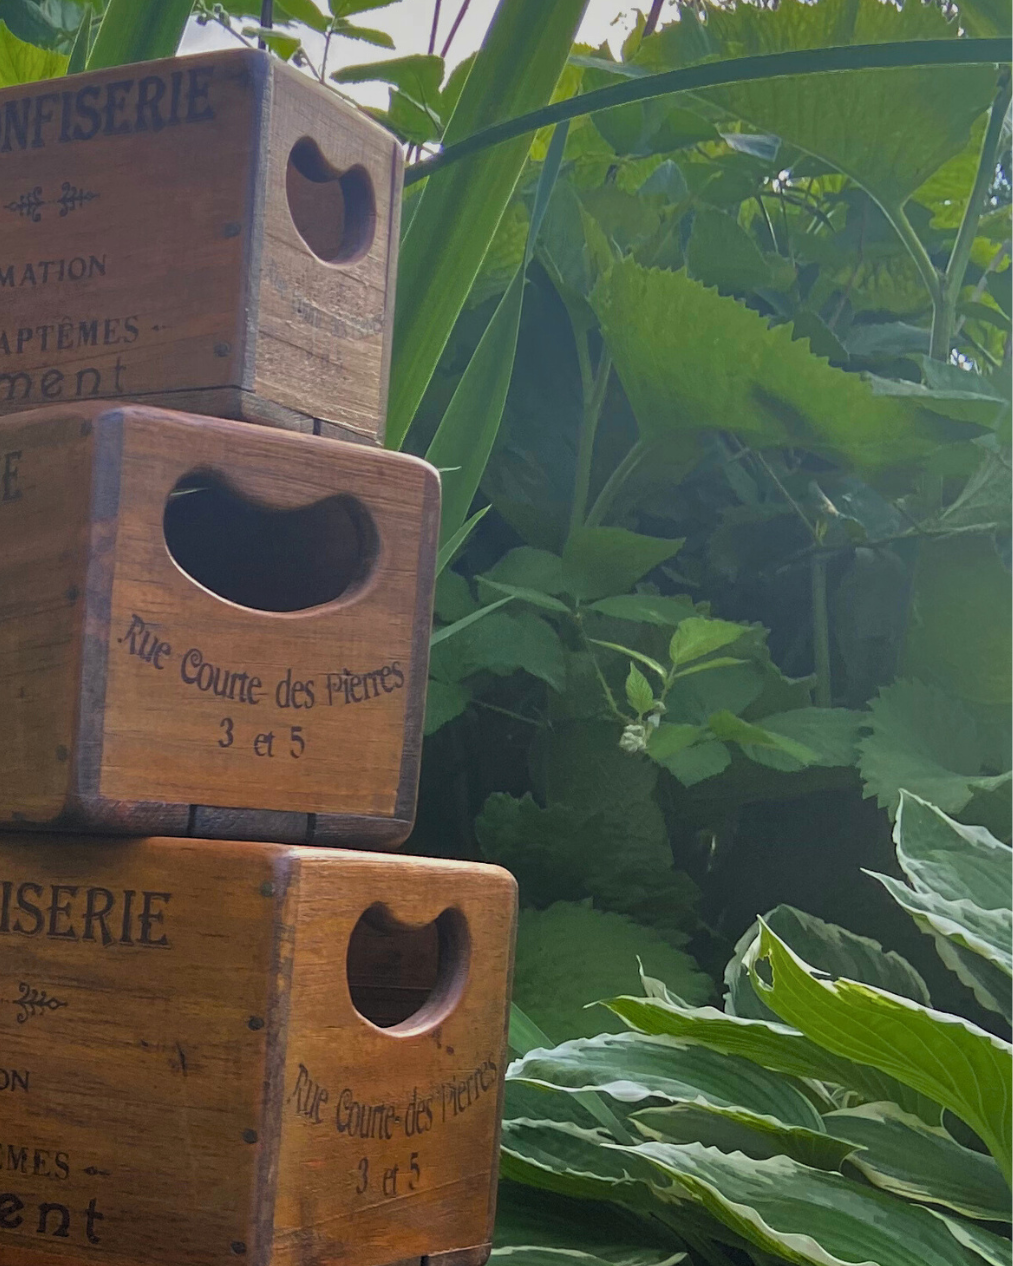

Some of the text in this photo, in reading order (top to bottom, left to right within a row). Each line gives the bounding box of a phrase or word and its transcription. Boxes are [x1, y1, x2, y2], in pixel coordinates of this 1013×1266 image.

[117, 614, 405, 709] Rue Courte des Pierres
[218, 718, 305, 759] 3 et 5
[288, 1063, 329, 1125] Rue
[336, 1088, 395, 1140] Courte
[405, 1087, 433, 1137] des
[356, 1152, 420, 1197] 3 et 5
